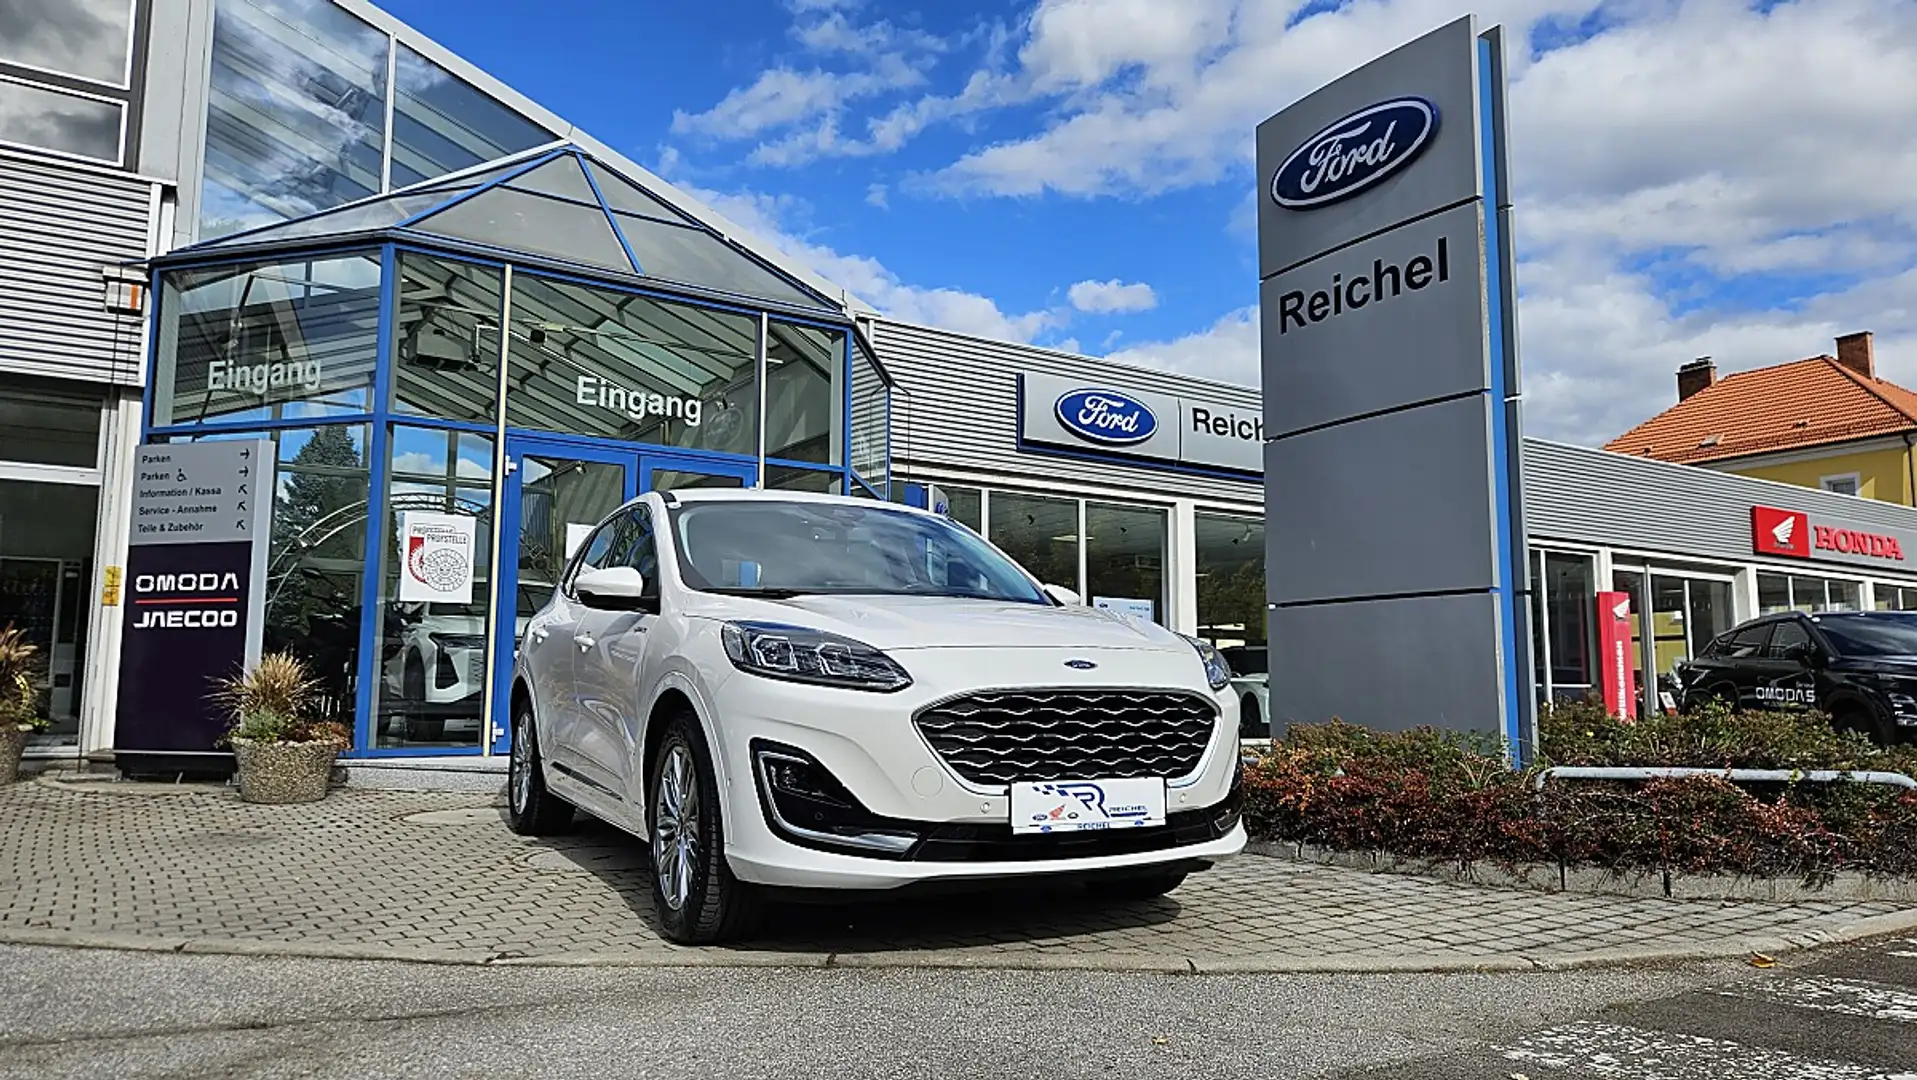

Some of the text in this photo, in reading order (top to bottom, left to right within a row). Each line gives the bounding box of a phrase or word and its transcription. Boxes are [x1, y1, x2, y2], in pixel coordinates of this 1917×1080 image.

[1300, 119, 1398, 193] Ford
[1279, 236, 1449, 335] Reichel
[207, 359, 321, 395] Eingang
[577, 375, 702, 427] Eingang
[1078, 395, 1140, 433] Ford
[142, 455, 171, 464] Parken
[140, 472, 171, 481] Parken
[139, 488, 188, 498] Information
[195, 487, 222, 496] Kassa
[138, 506, 170, 516] Service
[177, 505, 217, 514] Annahme
[137, 524, 157, 533] Teile
[167, 522, 204, 532] Zubehör
[1814, 525, 1904, 560] HONDA
[135, 572, 240, 592] OMODA
[133, 610, 238, 628] JAECOO
